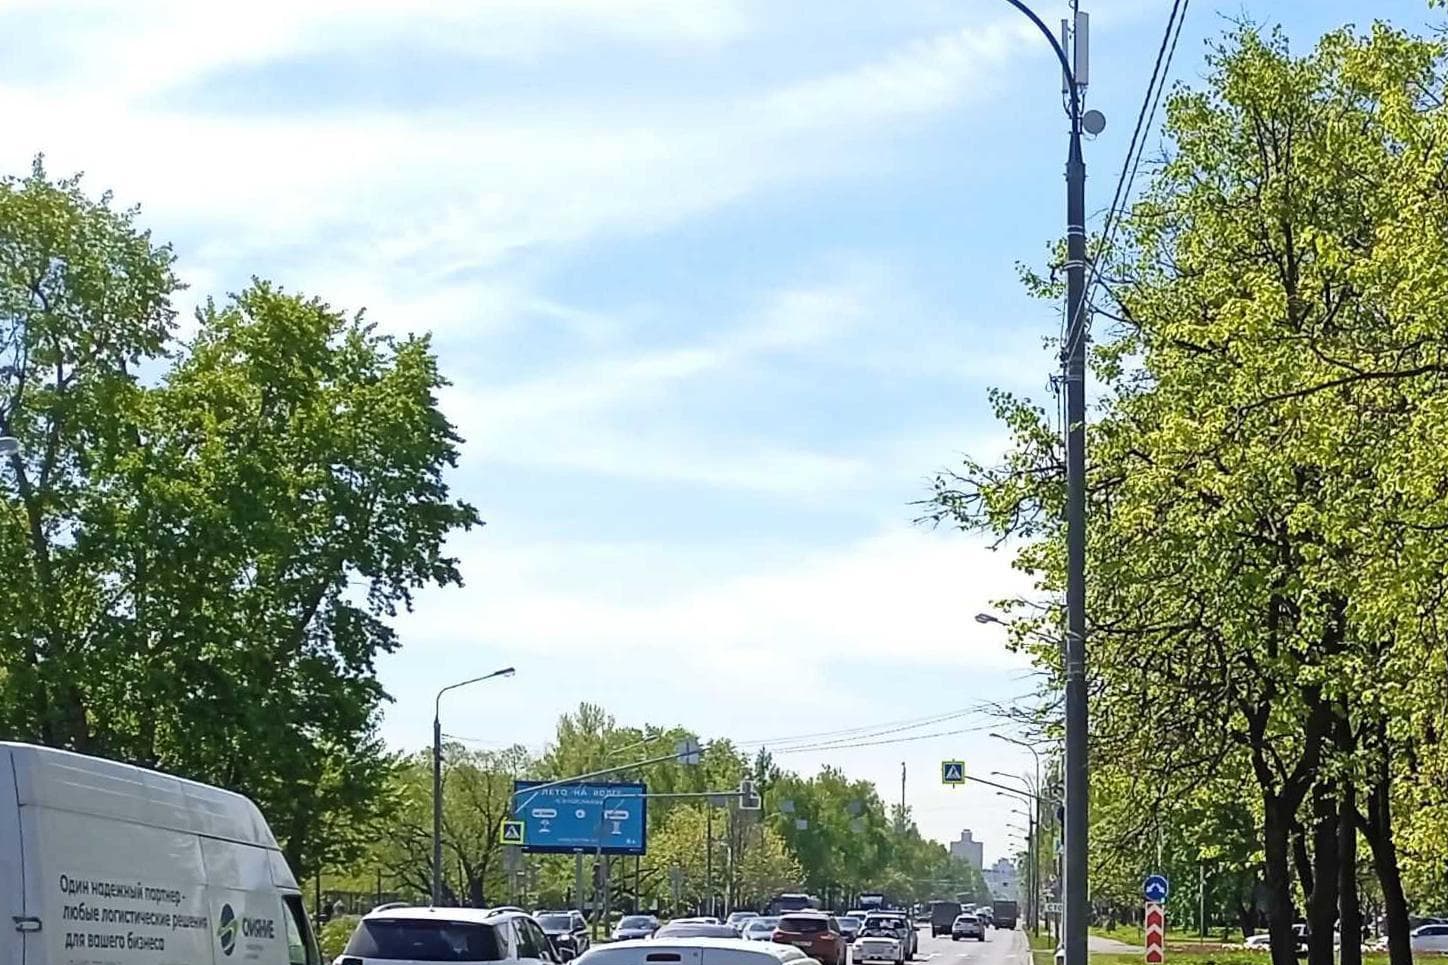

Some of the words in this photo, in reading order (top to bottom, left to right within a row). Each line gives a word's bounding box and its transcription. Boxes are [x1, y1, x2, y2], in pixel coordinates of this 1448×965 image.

[60, 874, 89, 896] Один
[91, 881, 144, 901] надежный
[144, 886, 181, 906] партнер
[63, 902, 100, 923] любые
[102, 907, 171, 928] логистические
[172, 913, 208, 931] решения
[65, 932, 86, 950] для
[88, 932, 125, 950] вашего
[127, 932, 165, 951] бизнеса
